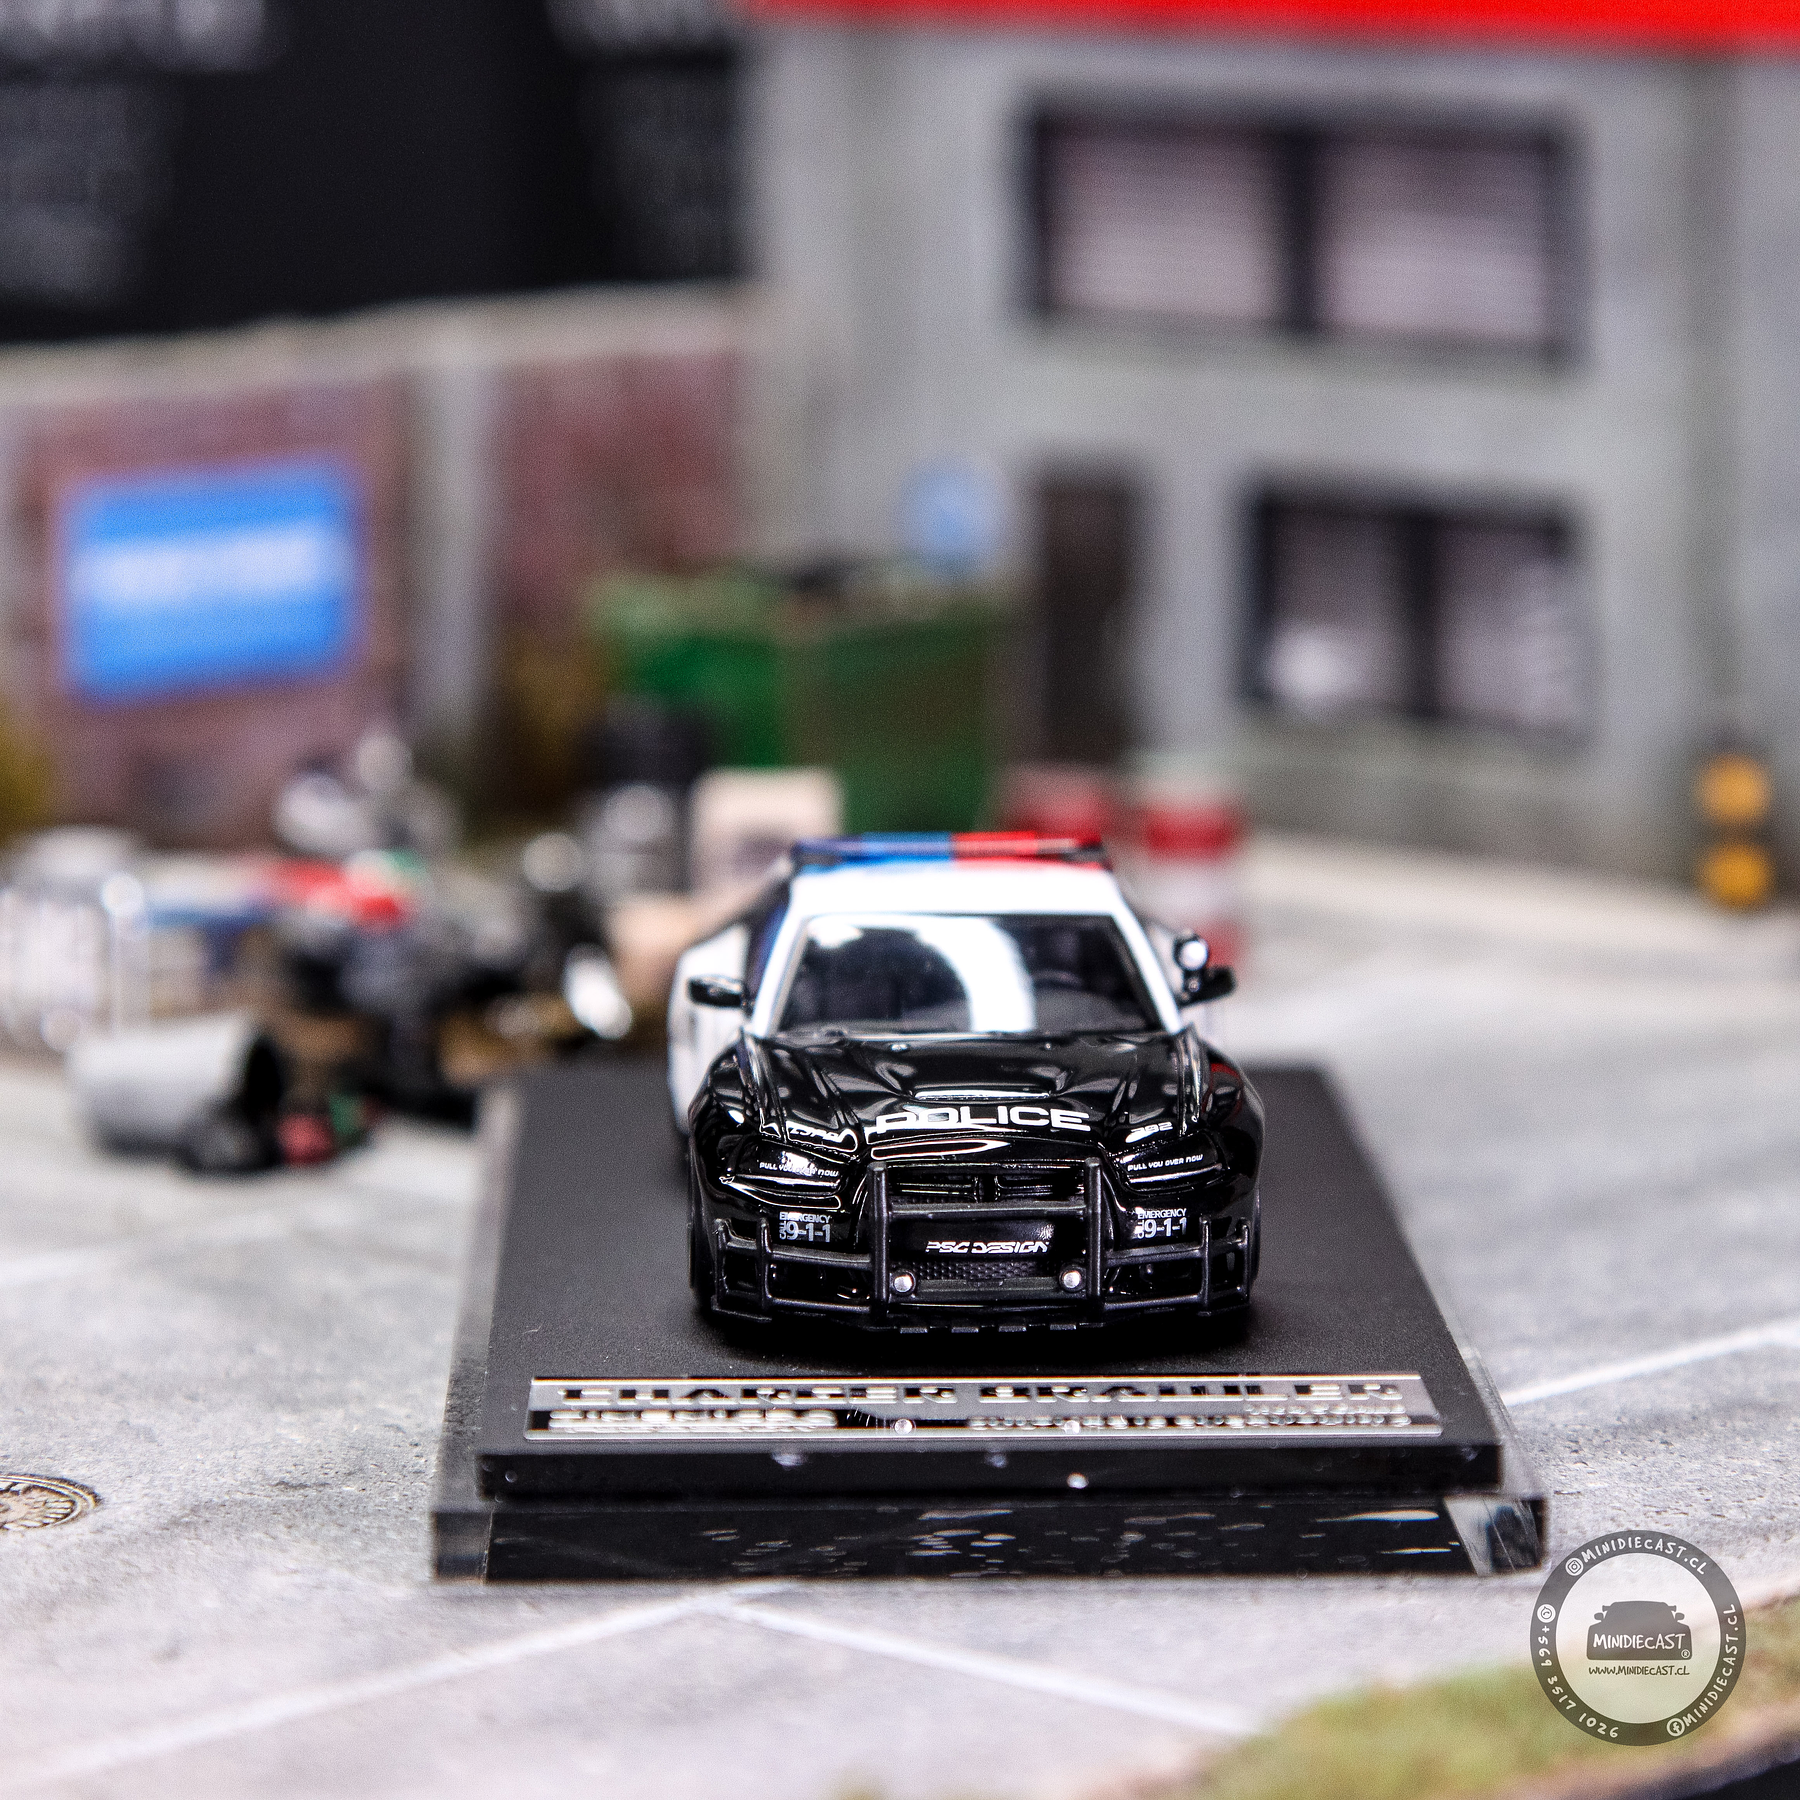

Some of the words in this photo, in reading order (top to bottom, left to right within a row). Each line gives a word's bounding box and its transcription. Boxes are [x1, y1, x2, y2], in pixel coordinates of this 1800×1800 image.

[876, 1105, 1091, 1134] POLICE
[760, 1162, 777, 1170] PULL
[1127, 1163, 1147, 1171] PULL
[1148, 1160, 1163, 1169] YOU
[1165, 1157, 1184, 1166] OVER
[779, 1212, 830, 1223] EMRGENCY
[1138, 1208, 1187, 1219] EMERGENCY
[787, 1221, 831, 1242] 9-1-1
[1144, 1217, 1187, 1239] 9-1-1
[971, 1241, 1050, 1253] DESIGN
